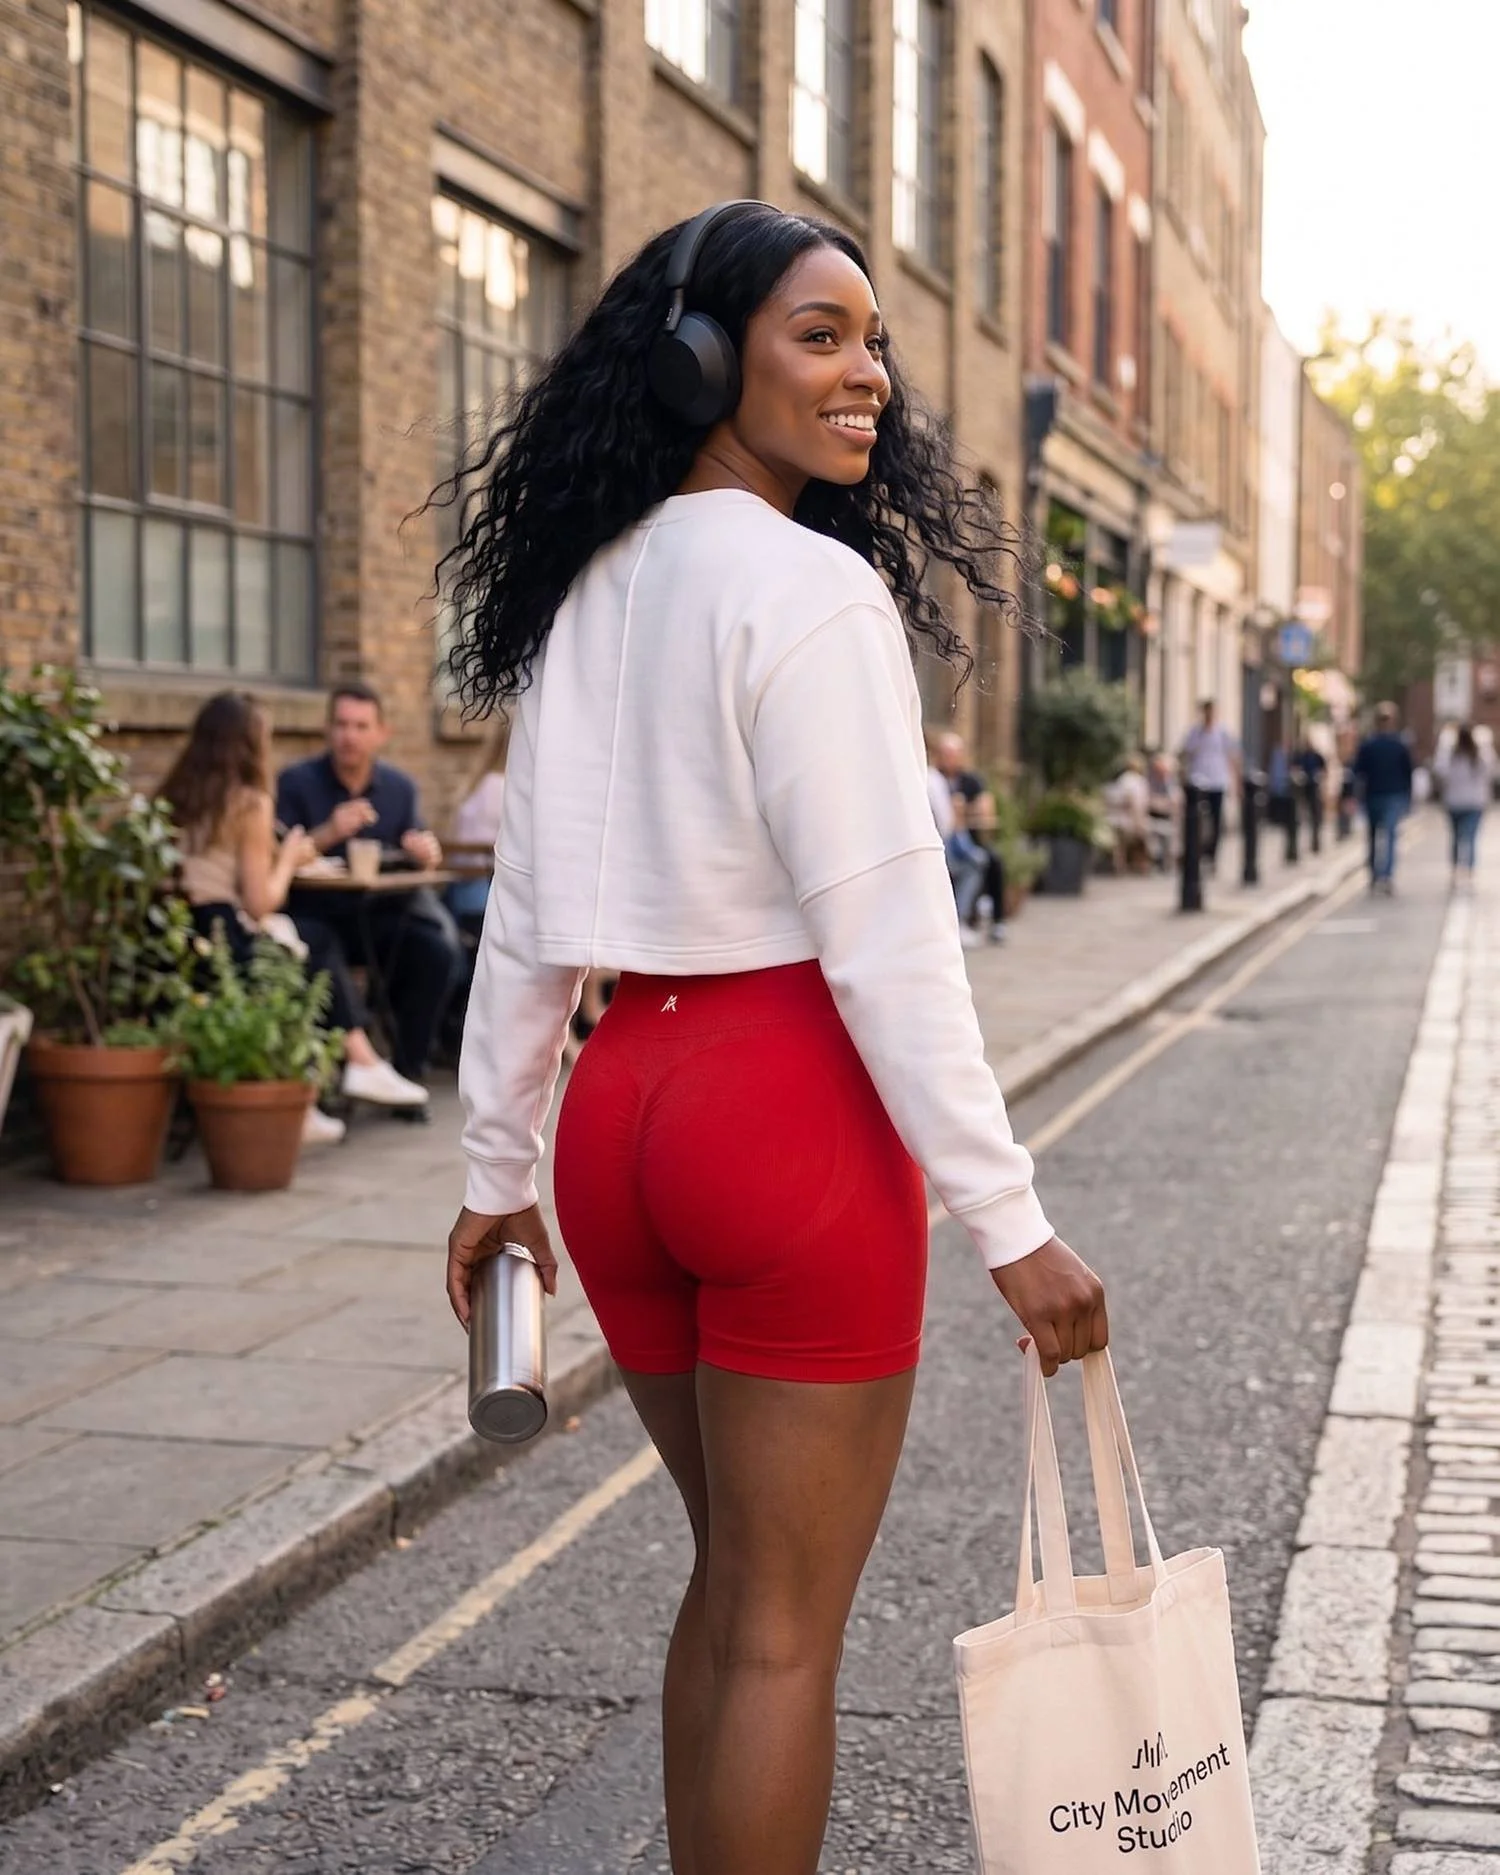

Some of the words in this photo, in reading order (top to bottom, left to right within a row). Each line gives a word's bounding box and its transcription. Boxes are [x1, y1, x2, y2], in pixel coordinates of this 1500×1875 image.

[1049, 1800, 1106, 1833] City
[1114, 1742, 1231, 1818] Movement
[1117, 1810, 1193, 1854] Studio
